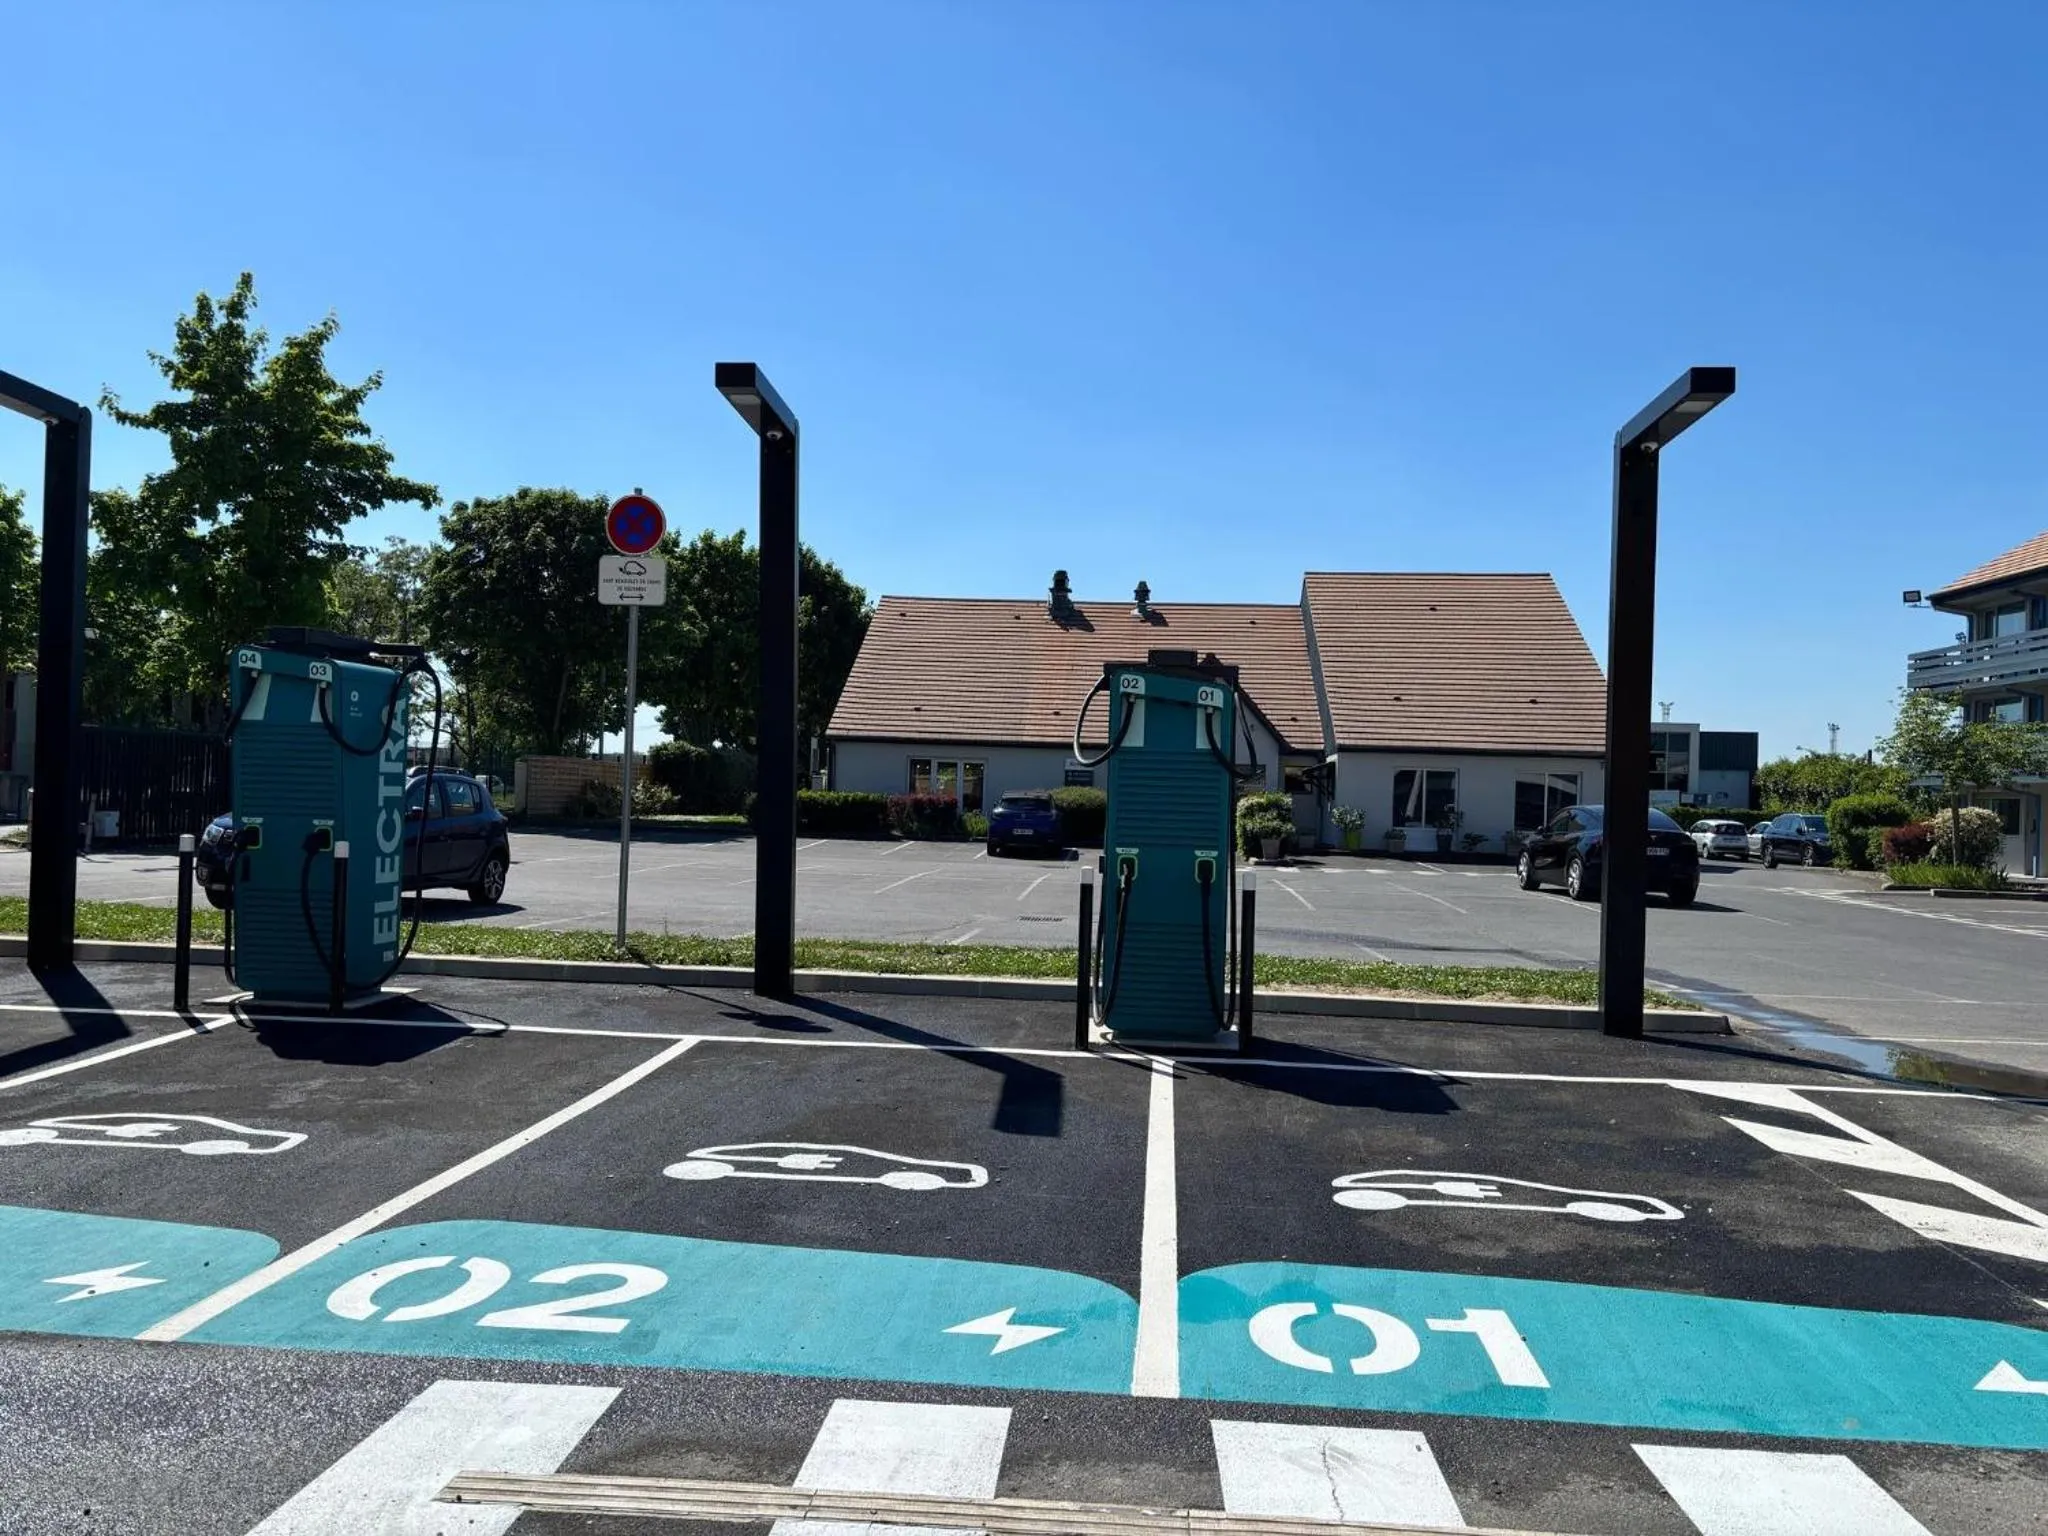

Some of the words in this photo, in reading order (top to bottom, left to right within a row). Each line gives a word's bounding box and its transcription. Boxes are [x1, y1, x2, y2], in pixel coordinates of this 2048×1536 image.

[240, 652, 256, 664] 04
[311, 664, 327, 676] 03
[1122, 679, 1138, 689] 02
[1200, 690, 1214, 701] 01
[373, 696, 408, 945] ELECTRA
[326, 1255, 668, 1333] 02
[1249, 1302, 1550, 1388] 01
